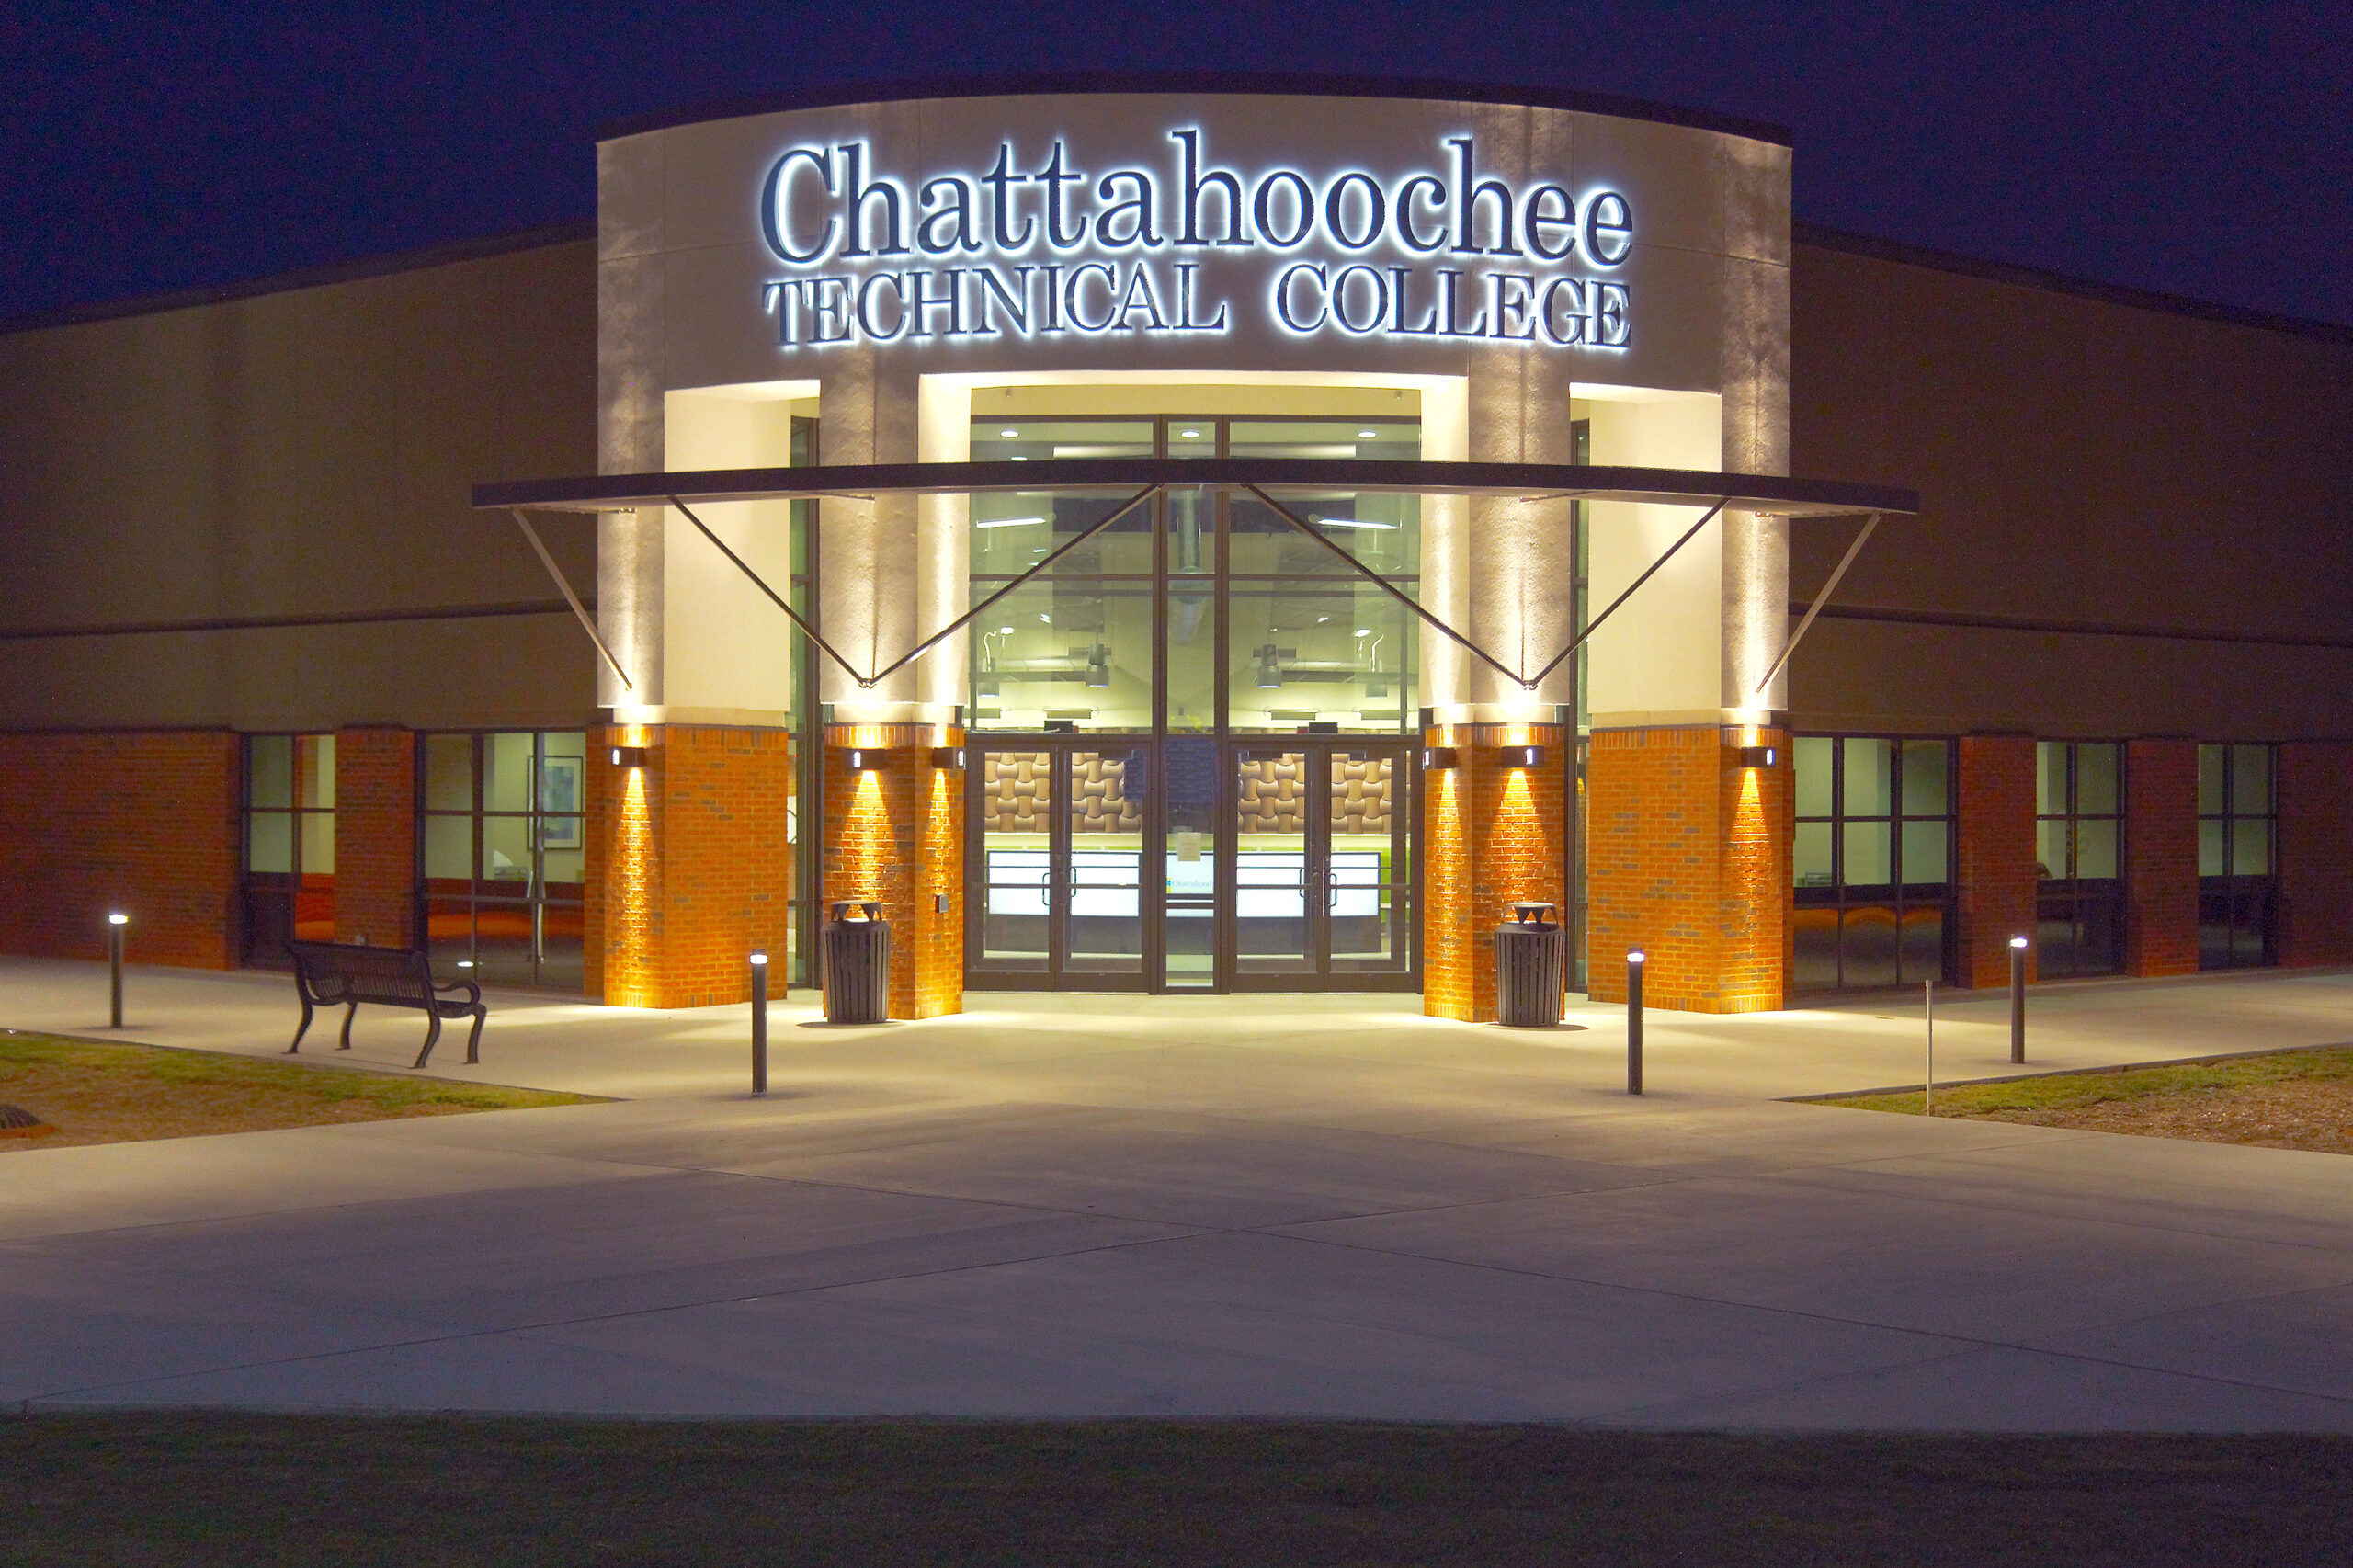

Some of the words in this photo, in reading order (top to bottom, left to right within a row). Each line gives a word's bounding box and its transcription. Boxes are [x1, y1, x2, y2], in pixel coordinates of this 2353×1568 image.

[761, 129, 1633, 266] Chattahoochee
[762, 261, 1226, 347] TECHNICAL
[1277, 263, 1631, 348] COLLEGE
